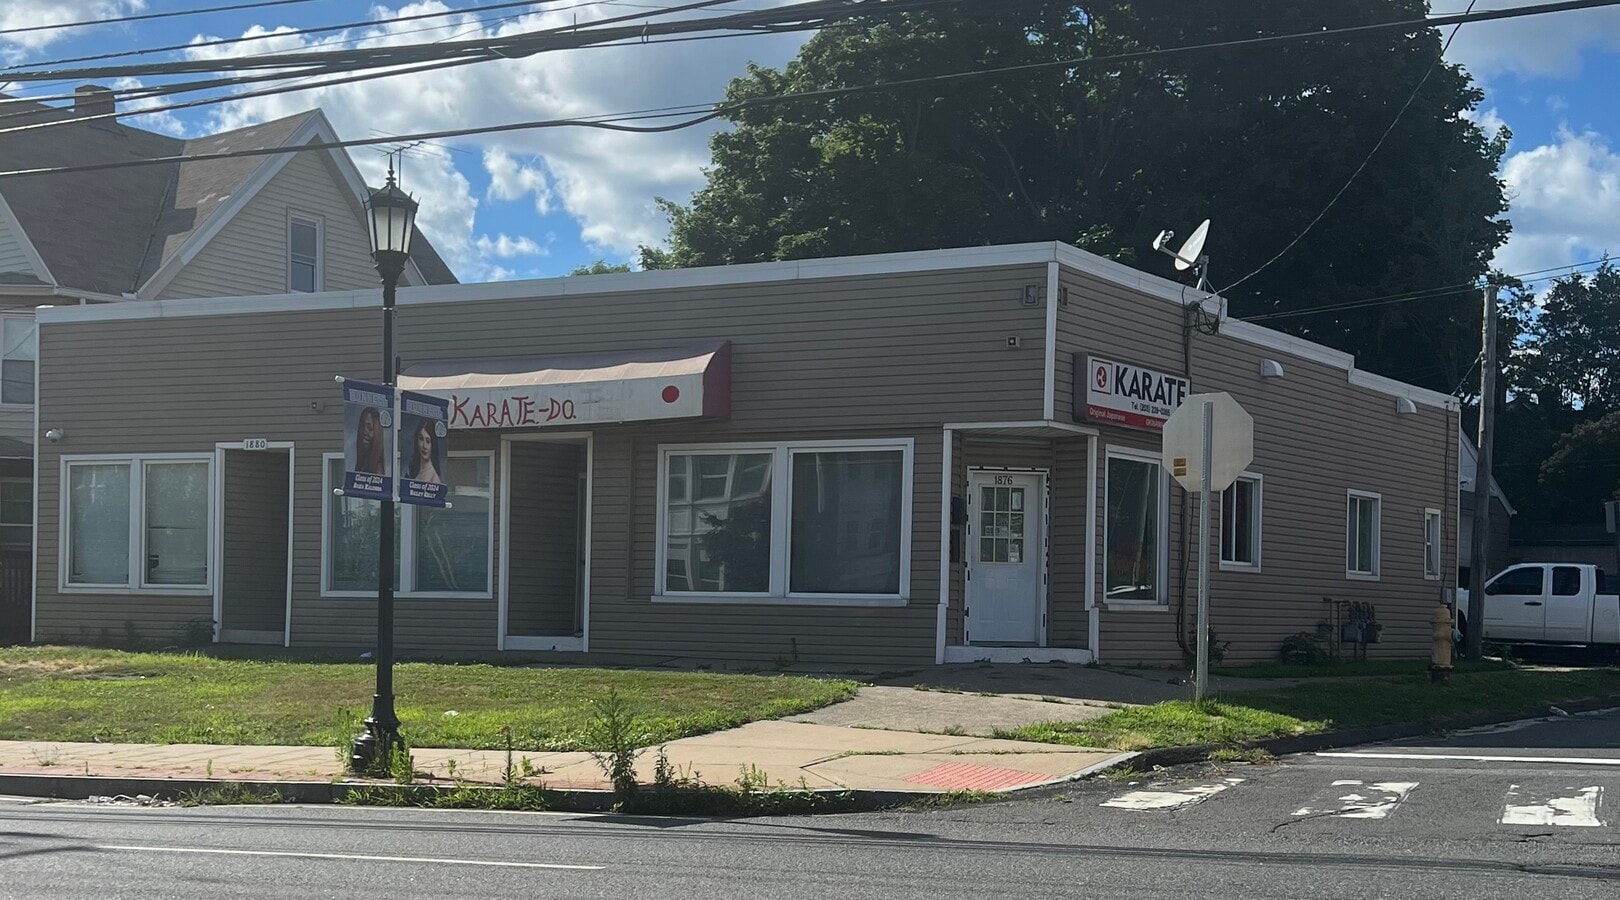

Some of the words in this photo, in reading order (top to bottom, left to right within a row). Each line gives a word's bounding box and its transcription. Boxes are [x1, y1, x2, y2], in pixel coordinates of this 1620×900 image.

[1115, 365, 1186, 407] KARATE
[1089, 408, 1106, 418] Original
[1107, 412, 1126, 421] Japanese
[246, 440, 265, 449] 1880
[355, 474, 366, 482] Class
[372, 476, 383, 484] 2024
[995, 475, 1013, 485] 1876
[409, 481, 421, 490] Class
[428, 484, 439, 492] 2024
